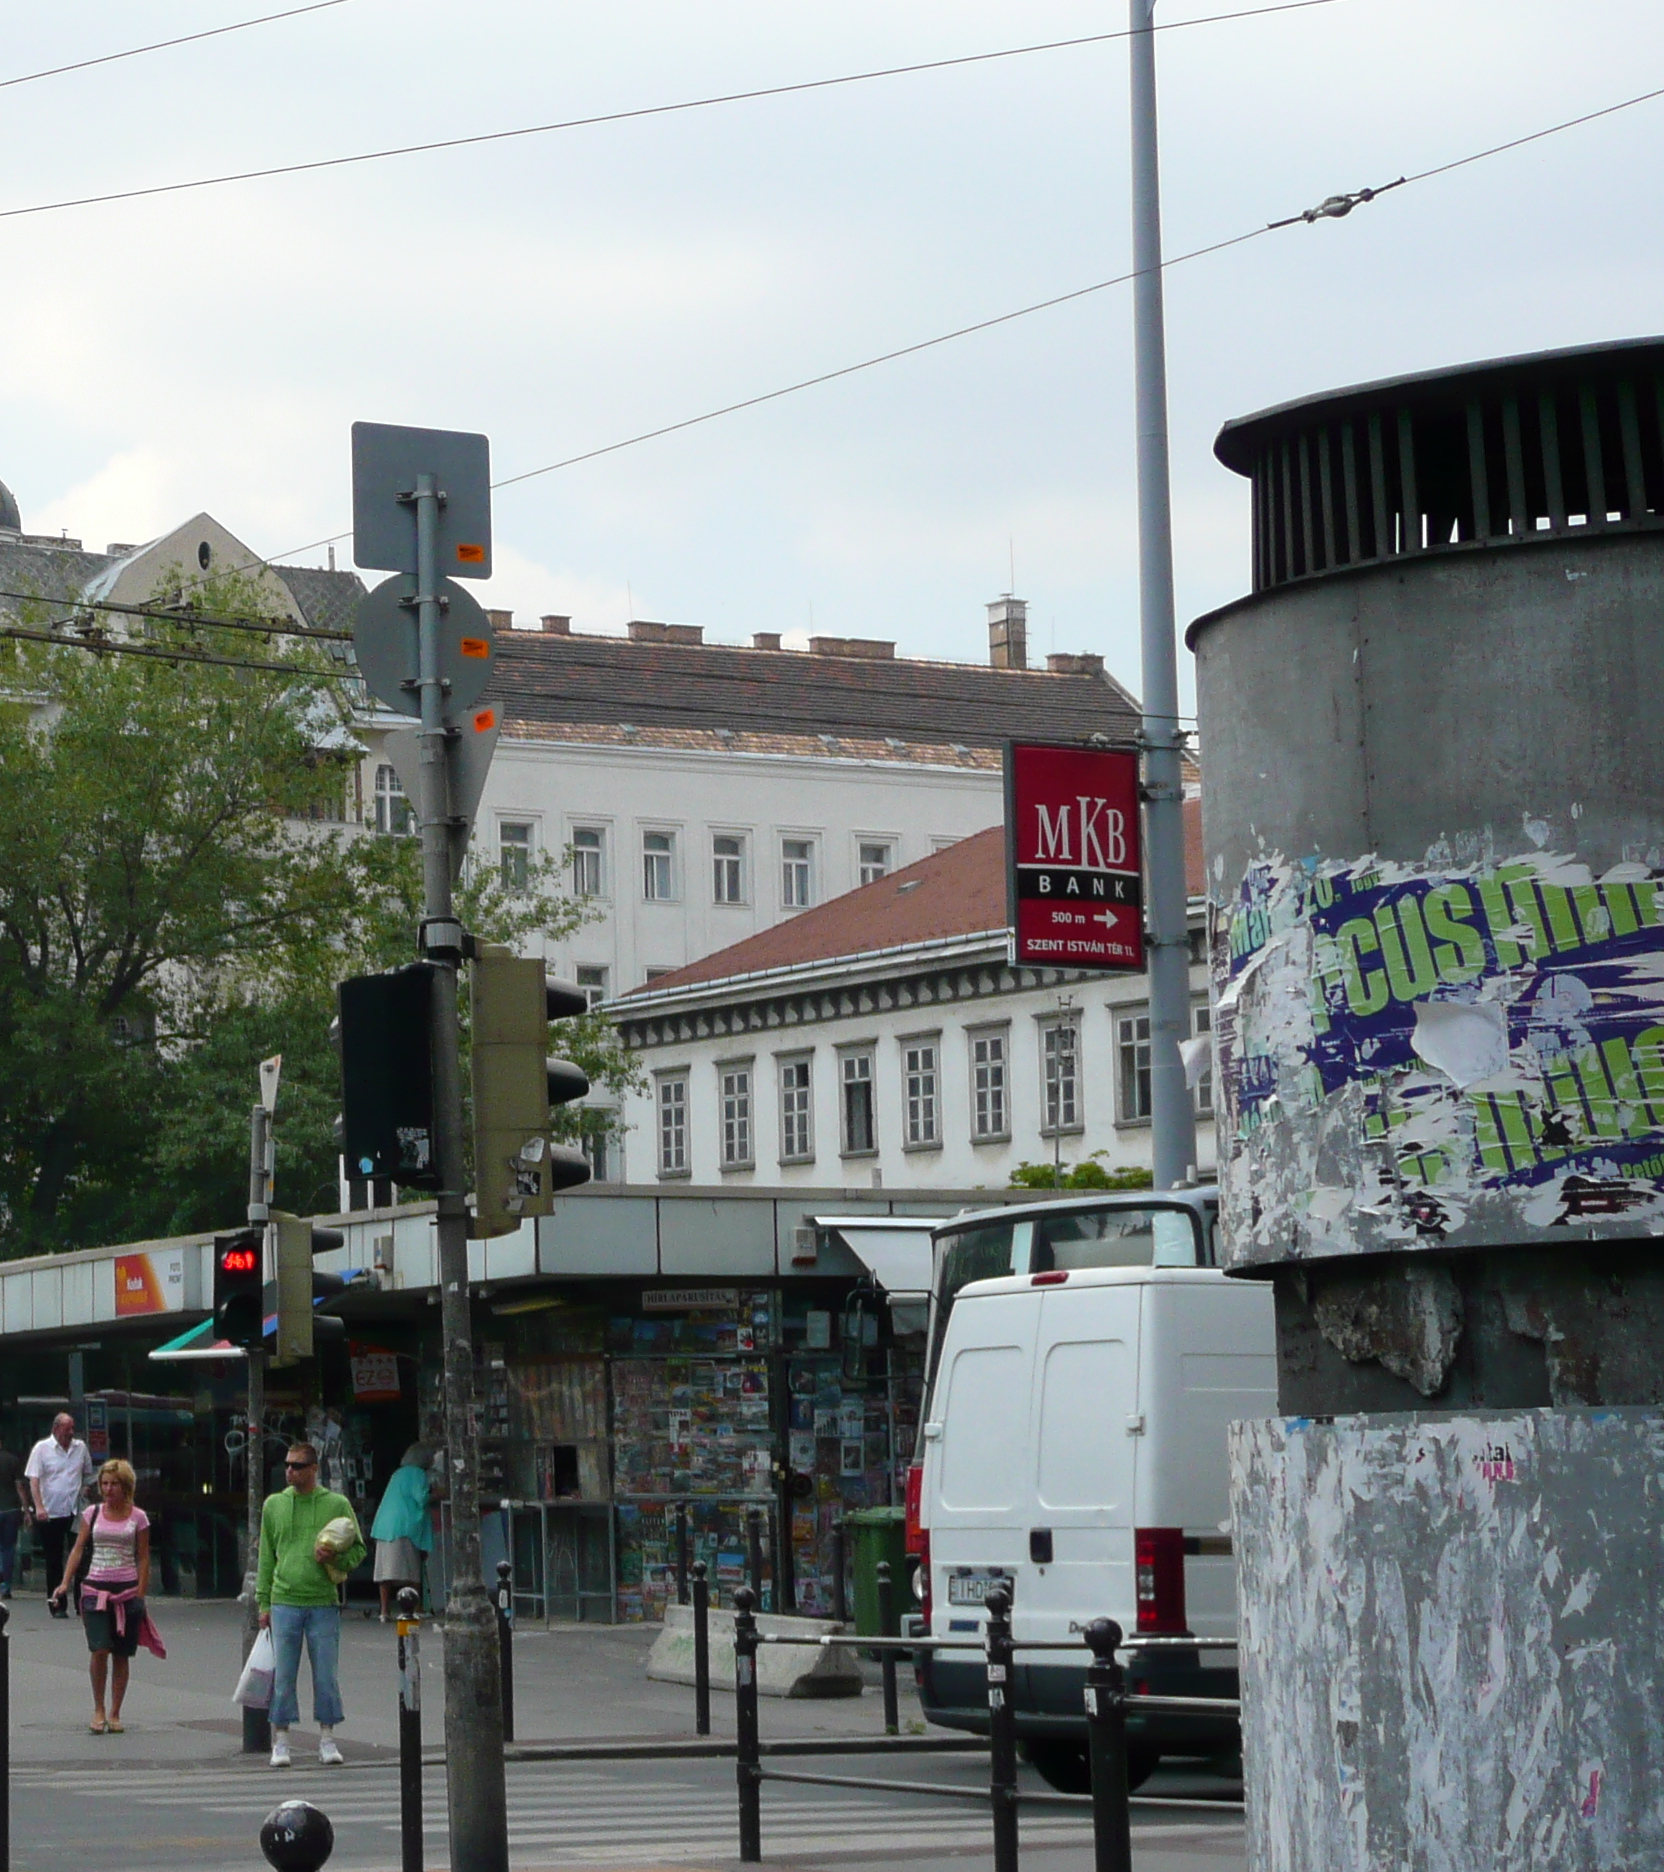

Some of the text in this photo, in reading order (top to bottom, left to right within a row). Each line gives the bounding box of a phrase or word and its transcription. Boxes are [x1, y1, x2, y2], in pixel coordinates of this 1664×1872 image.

[1034, 795, 1127, 869] MKB
[1038, 875, 1125, 899] BANK
[1051, 911, 1086, 924] 500 m
[1026, 938, 1065, 951] SZENT
[1067, 938, 1105, 955] ISTVÁN
[1106, 942, 1123, 955] TÉR
